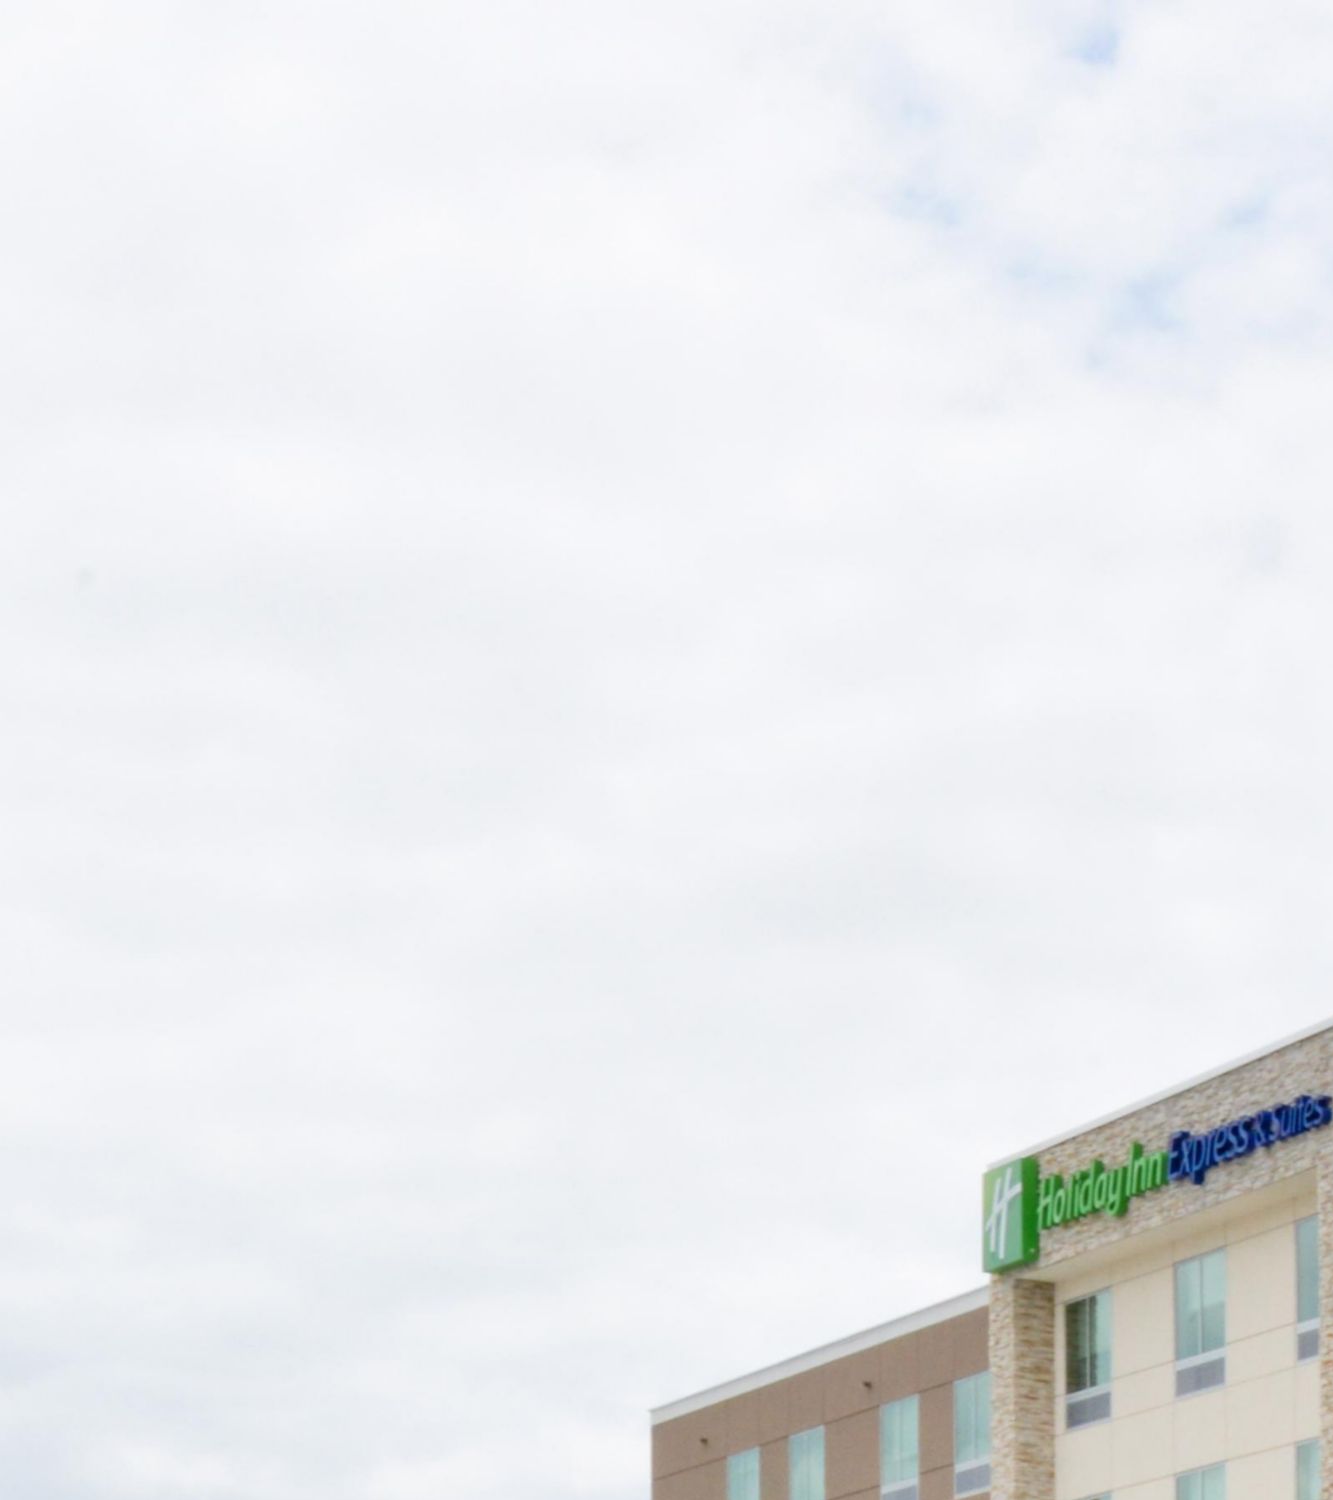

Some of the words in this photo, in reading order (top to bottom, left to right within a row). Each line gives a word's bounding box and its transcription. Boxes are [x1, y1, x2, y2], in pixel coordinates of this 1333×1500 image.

[1037, 1158, 1126, 1234] Holiday
[1125, 1141, 1168, 1197] Inn
[1168, 1131, 1252, 1184] Express
[1252, 1110, 1275, 1148] &
[1270, 1095, 1333, 1142] Suites
